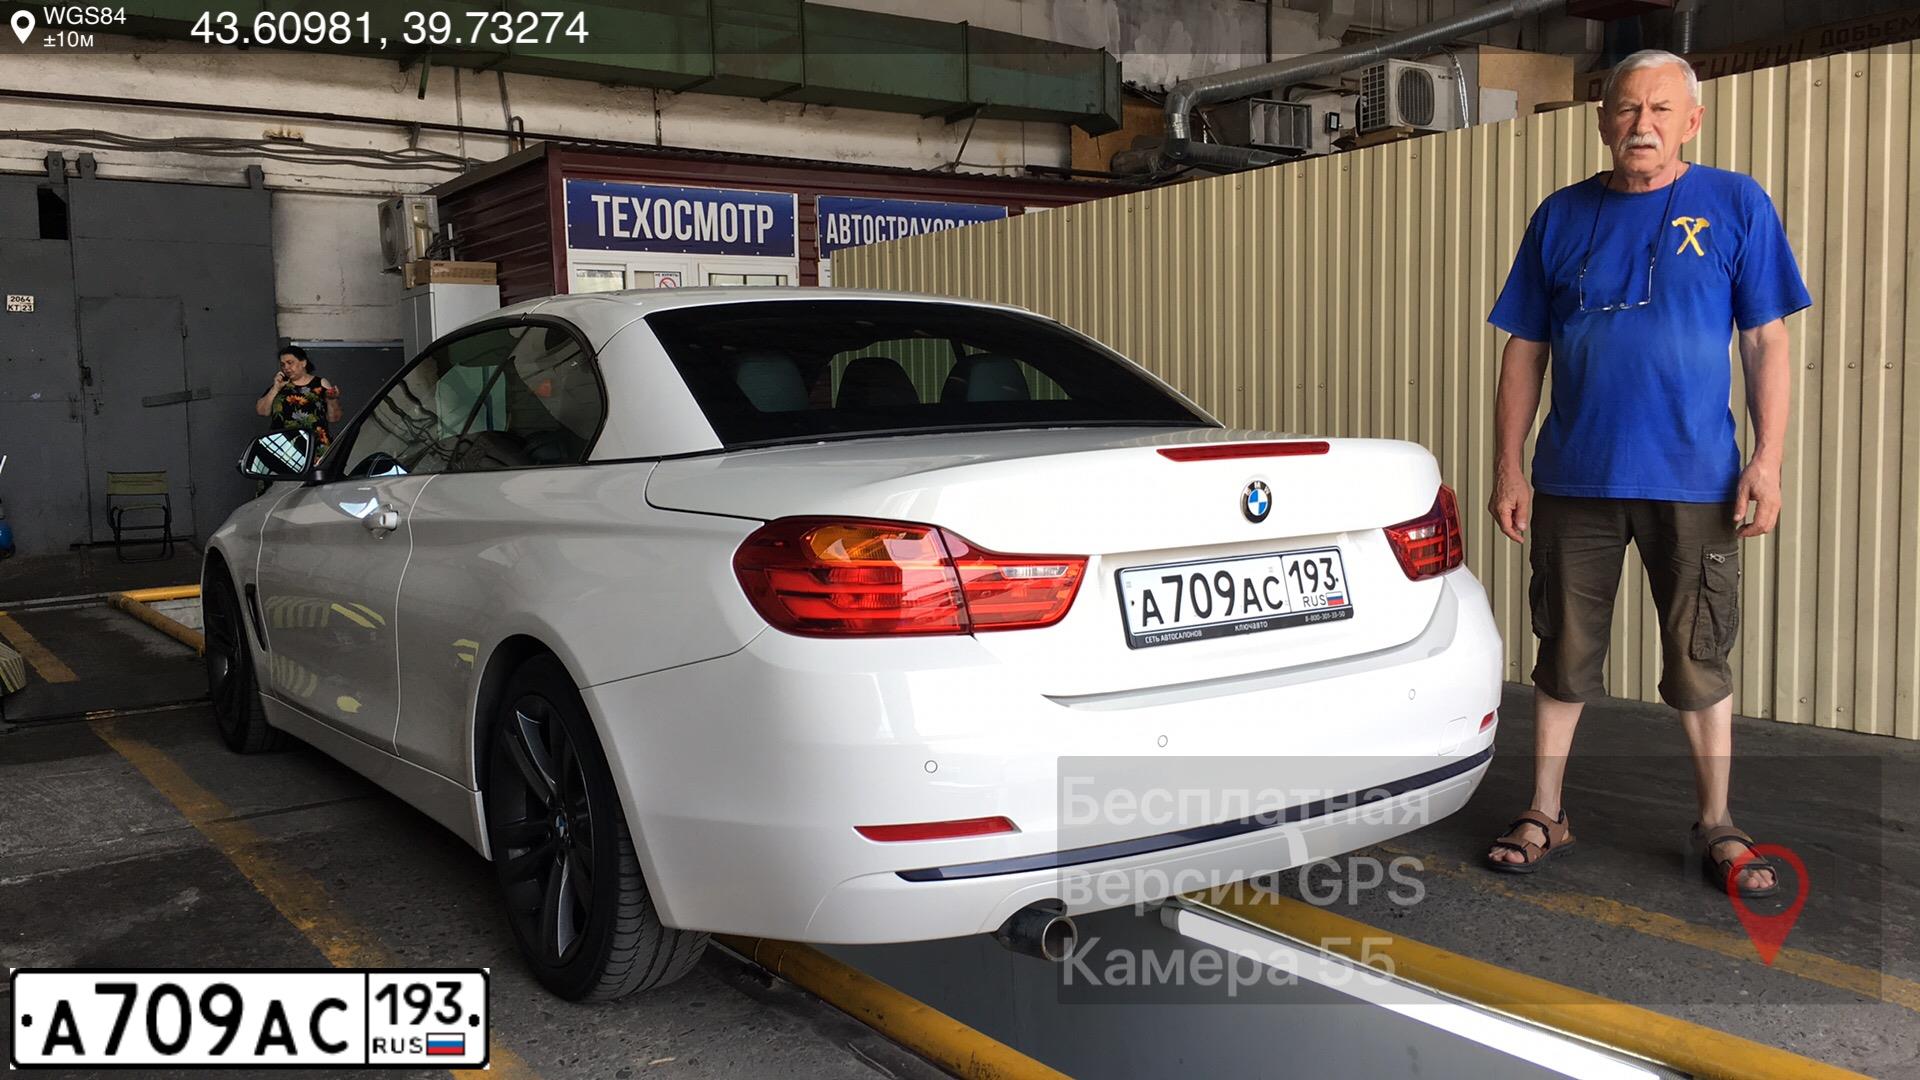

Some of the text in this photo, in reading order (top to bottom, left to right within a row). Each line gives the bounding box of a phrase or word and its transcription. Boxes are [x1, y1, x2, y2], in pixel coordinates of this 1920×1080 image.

[590, 194, 774, 244] ТЕХОСМОТР
[1288, 557, 1336, 594] 193
[1302, 593, 1327, 608] RUS
[1144, 629, 1203, 644] СЕТЬ АВТОСАЛОНОВ
